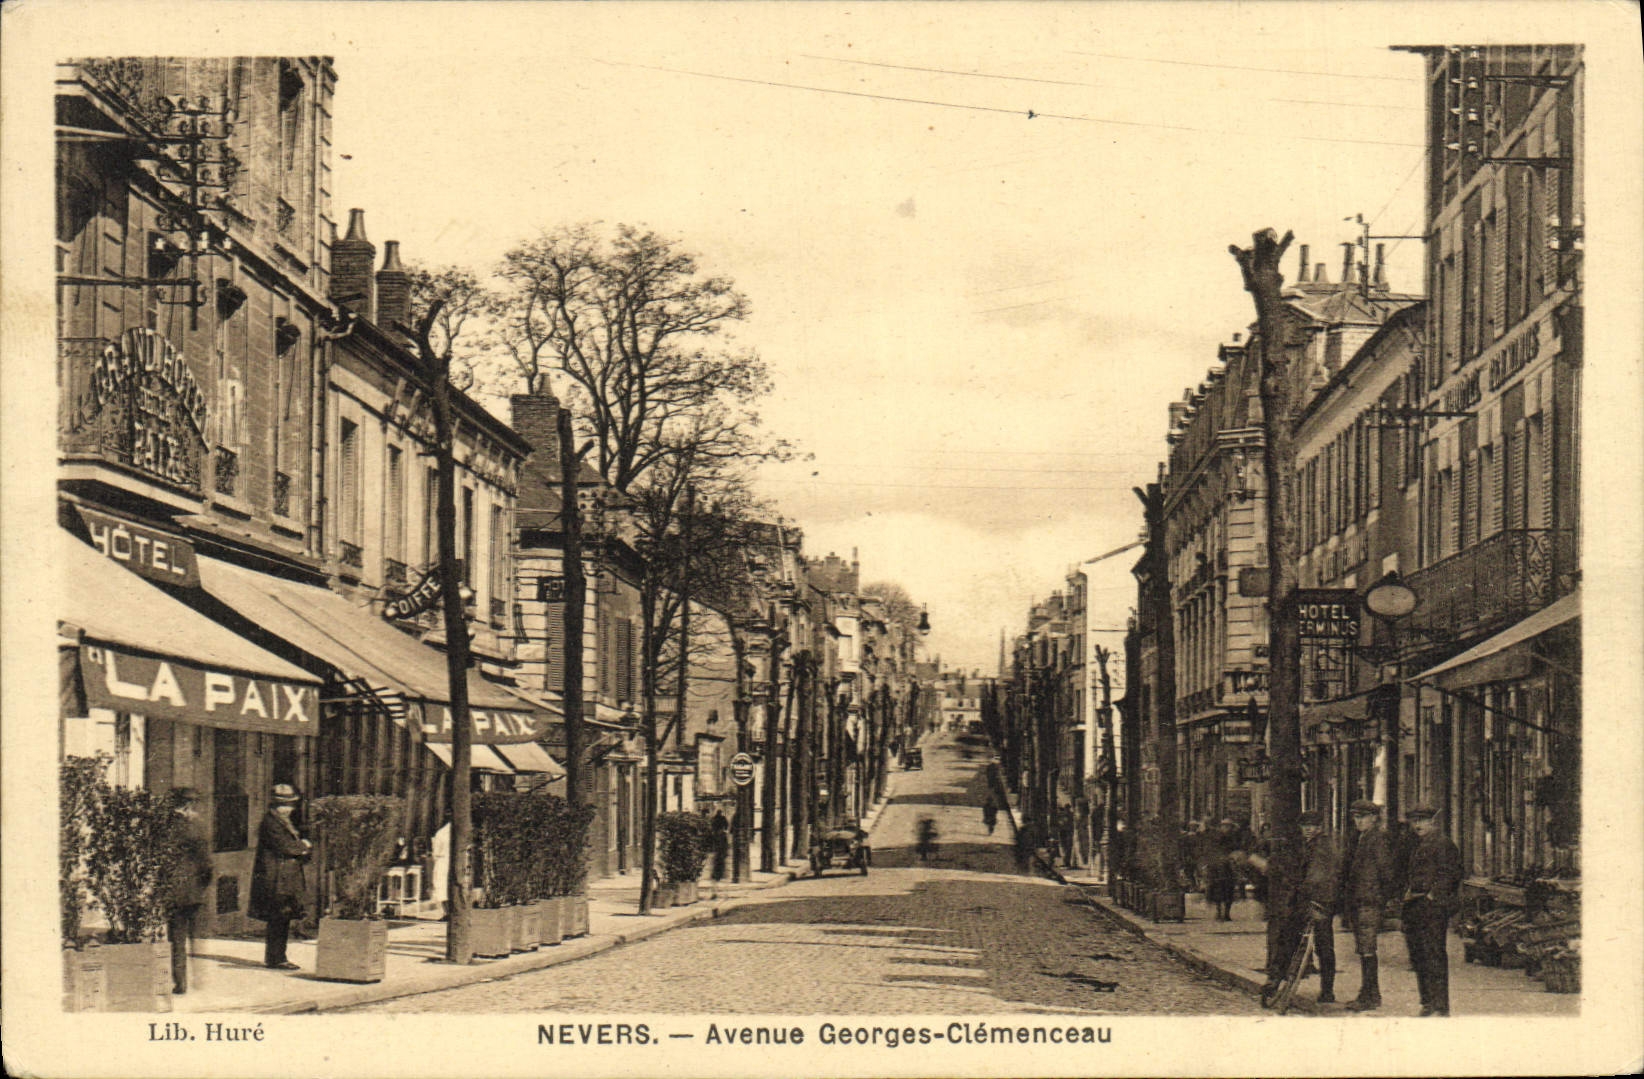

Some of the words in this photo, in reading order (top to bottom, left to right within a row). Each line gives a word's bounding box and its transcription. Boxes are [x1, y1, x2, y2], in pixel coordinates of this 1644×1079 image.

[385, 576, 441, 616] COIFFE
[1298, 604, 1350, 620] HOTEL
[1299, 620, 1358, 636] ERMINUS
